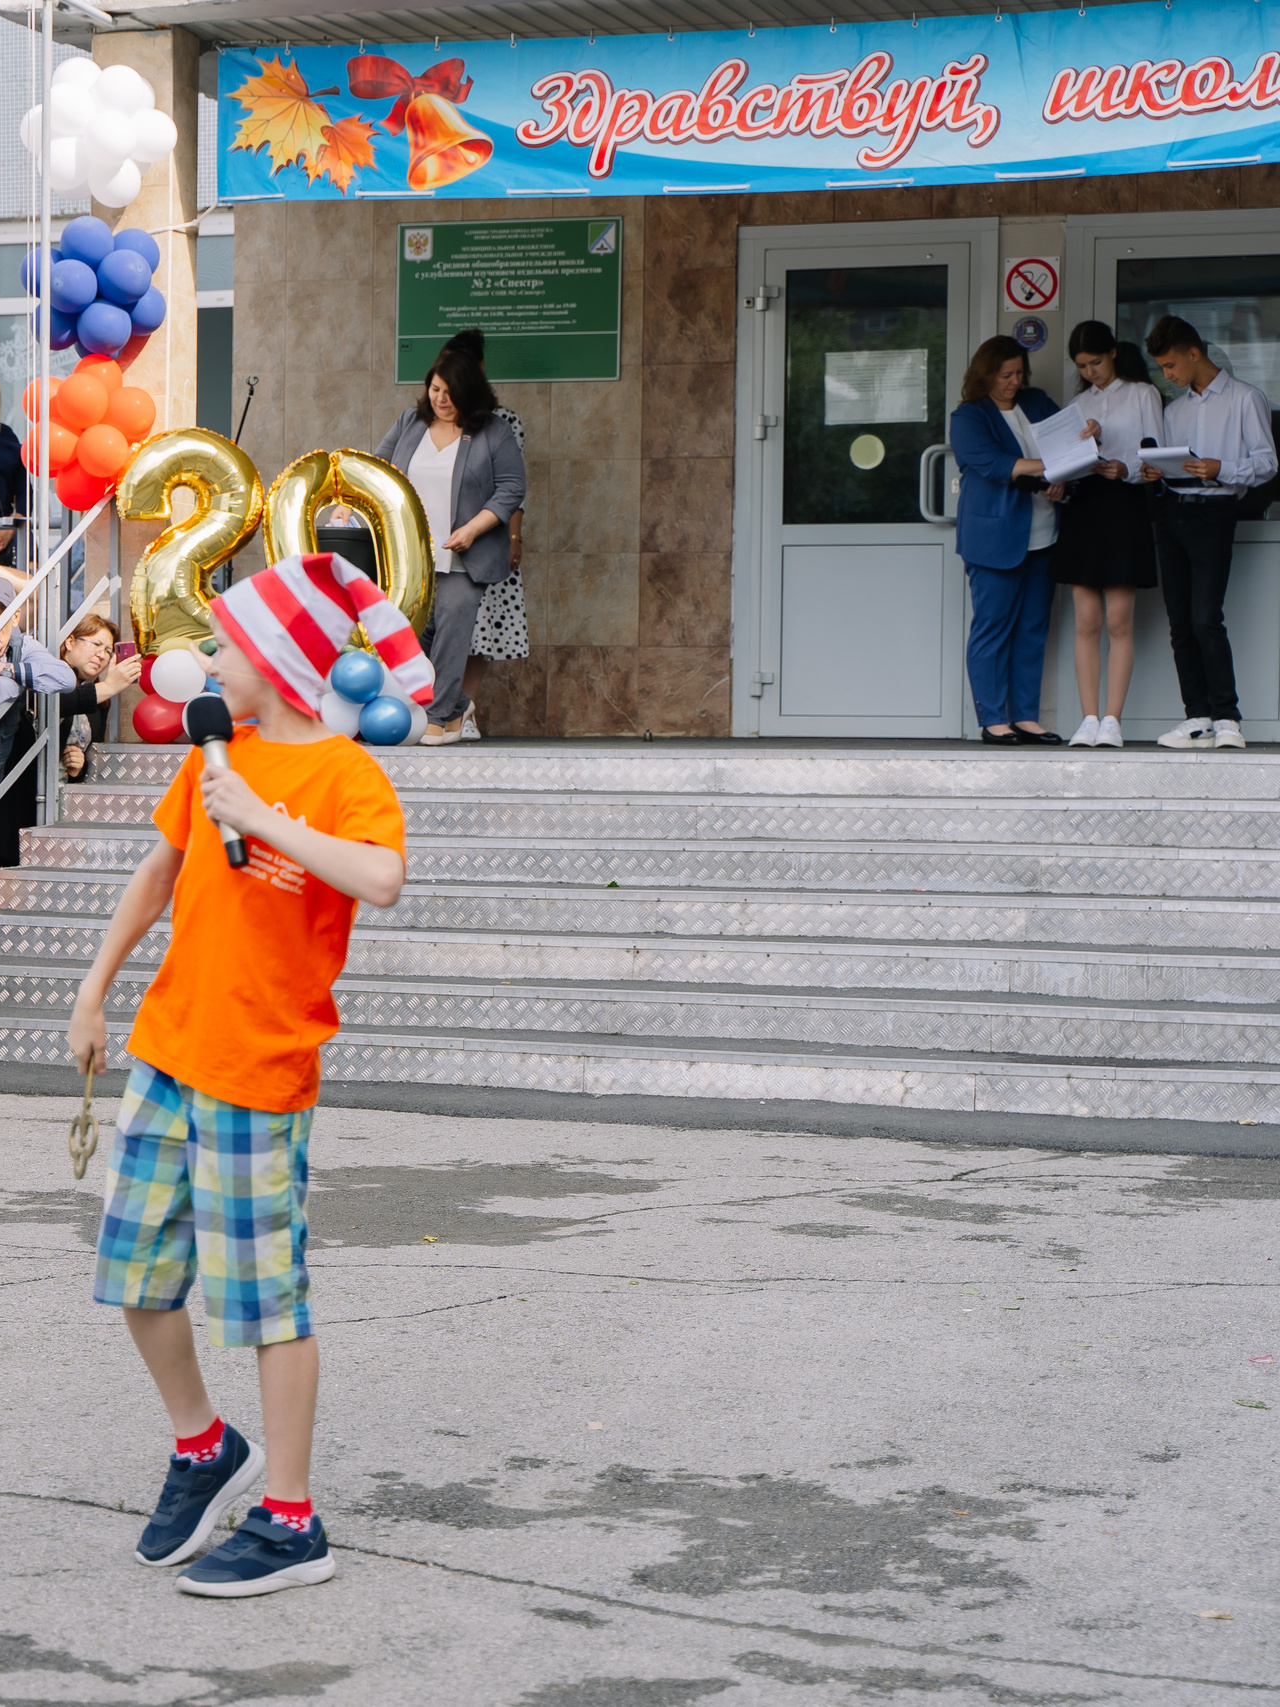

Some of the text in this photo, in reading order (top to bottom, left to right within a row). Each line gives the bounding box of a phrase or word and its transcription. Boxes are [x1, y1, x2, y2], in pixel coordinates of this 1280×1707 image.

[515, 50, 1280, 179] Здравствуй, школ
[471, 277, 545, 289] № 2 «Спектр»
[116, 427, 436, 656] 20
[248, 857, 279, 874] ummer
